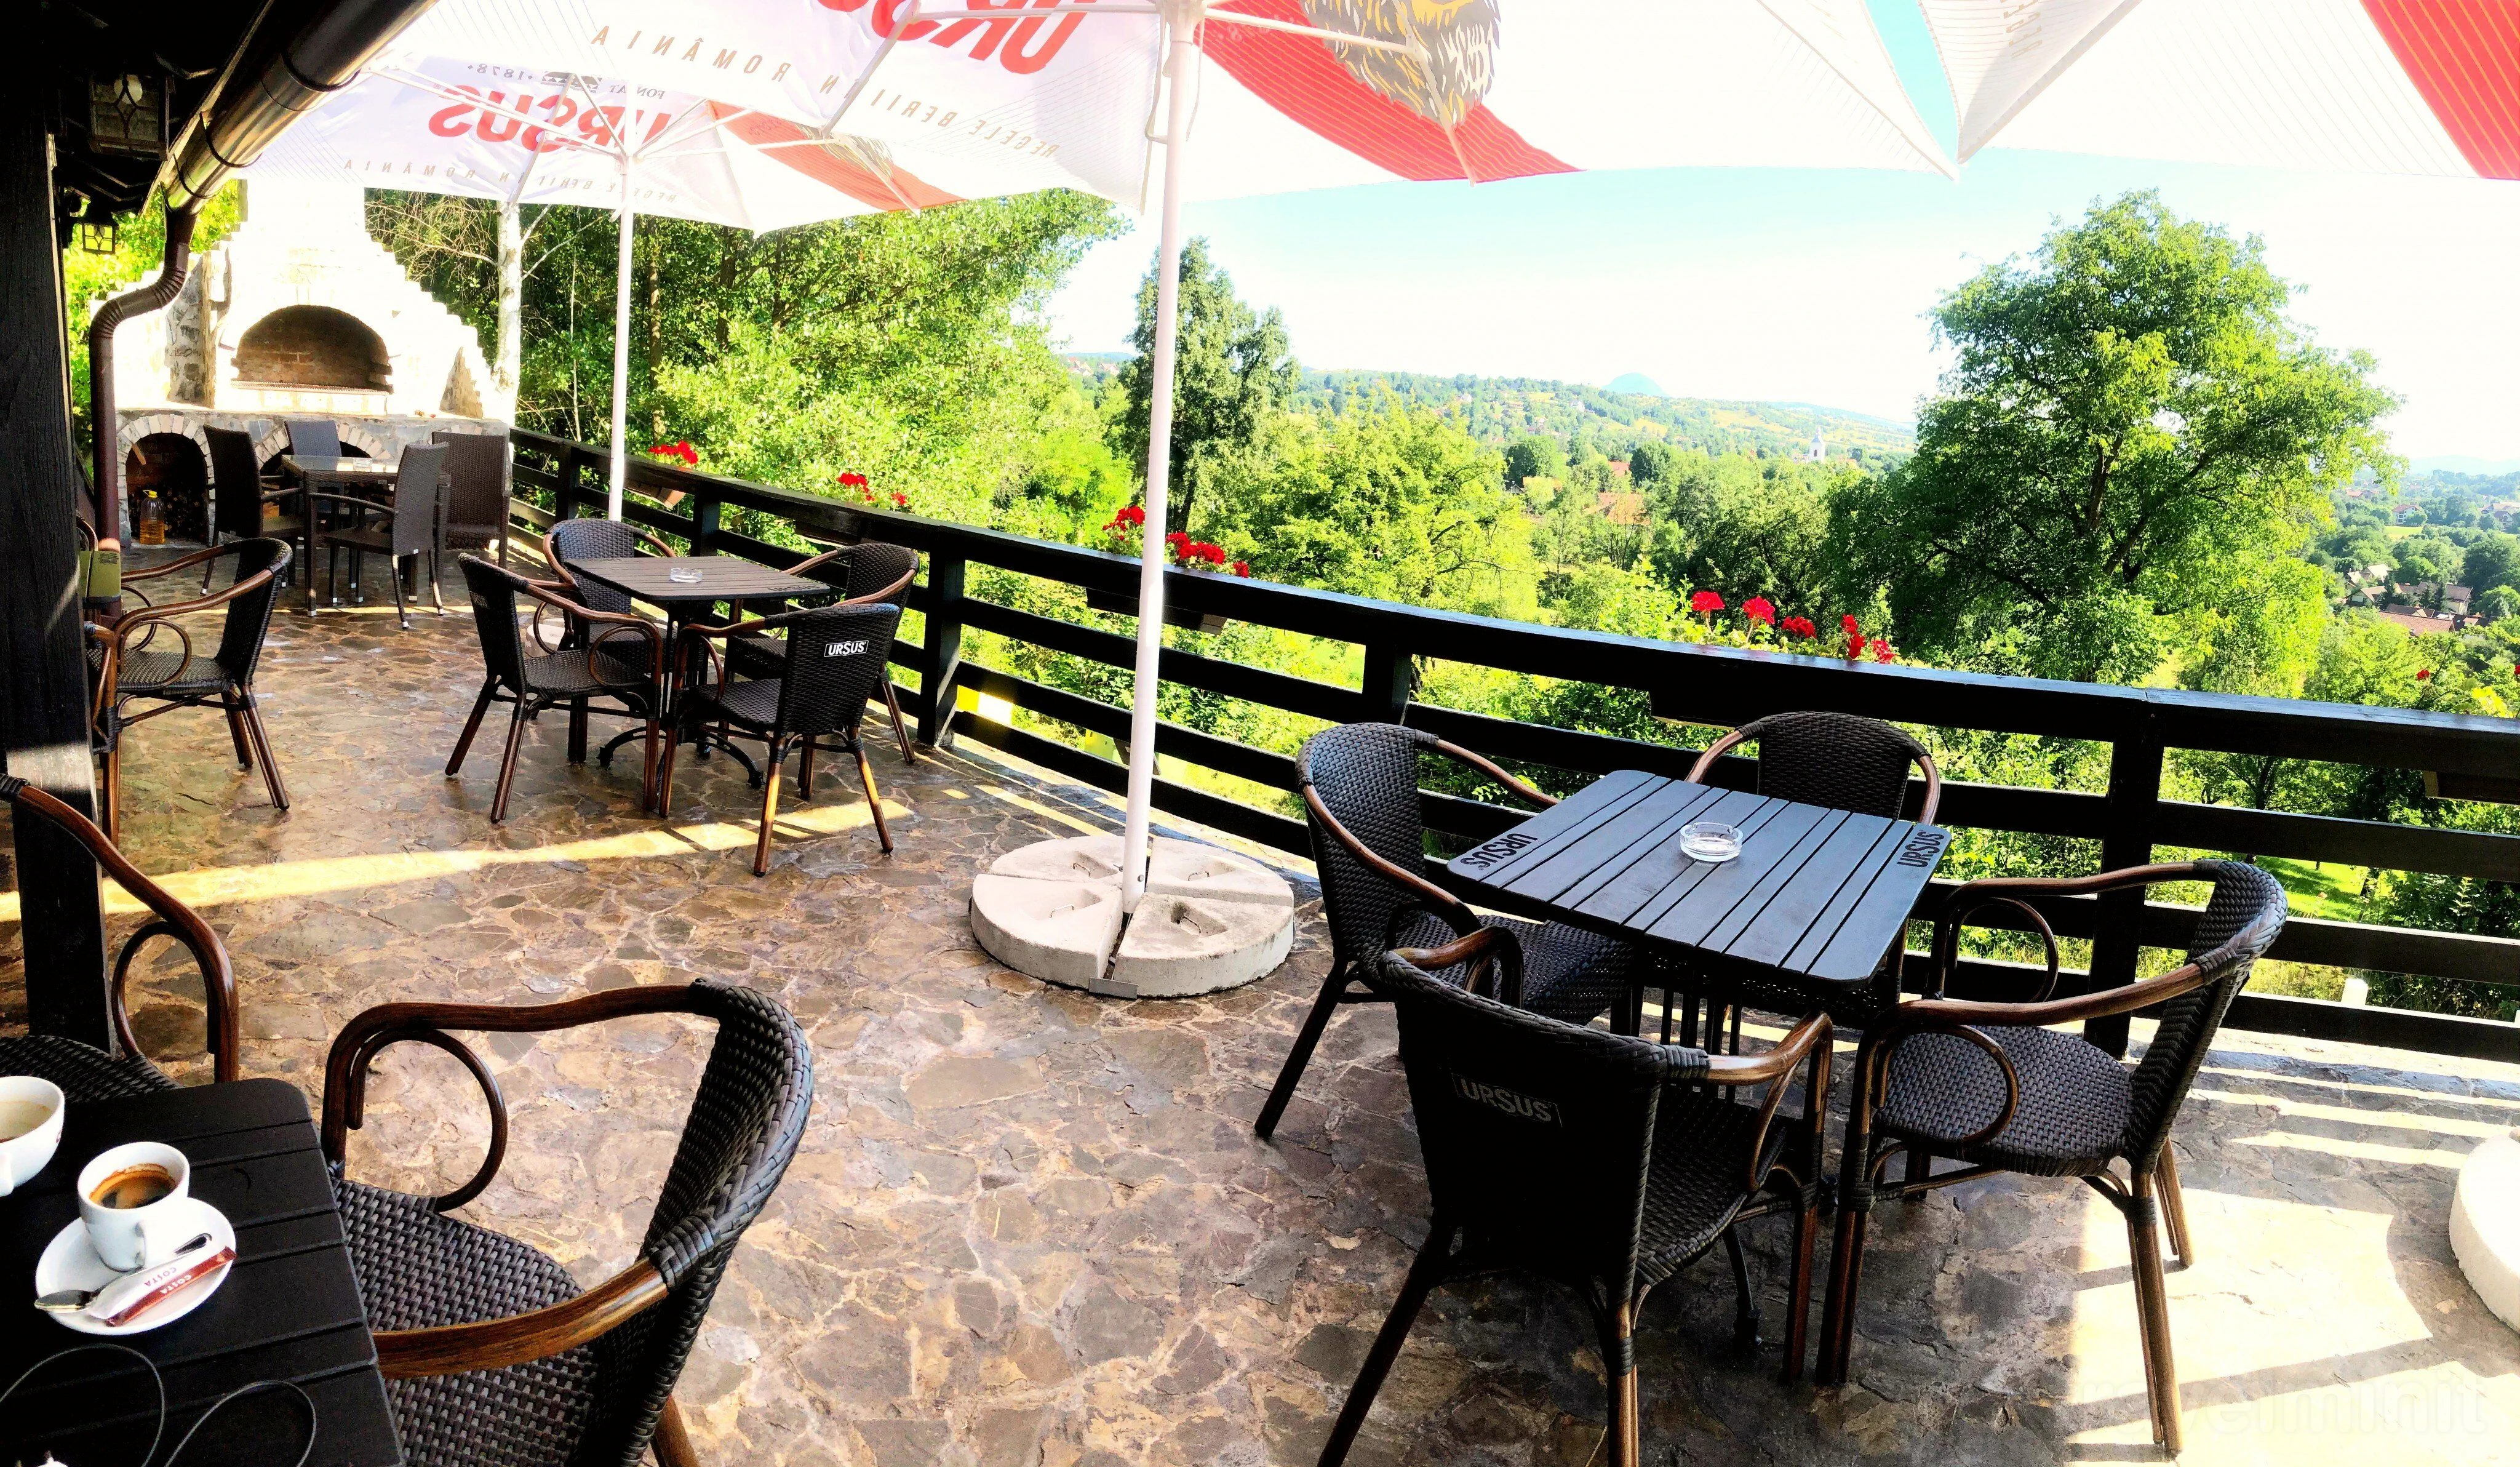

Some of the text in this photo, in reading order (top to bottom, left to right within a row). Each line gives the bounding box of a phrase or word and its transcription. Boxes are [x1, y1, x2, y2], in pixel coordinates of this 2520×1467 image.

[828, 641, 866, 656] URSUS
[1460, 833, 1539, 871] URSUS
[1897, 830, 1944, 868] URSUS
[1461, 1078, 1552, 1122] URSUS
[144, 1267, 177, 1287] COSTA
